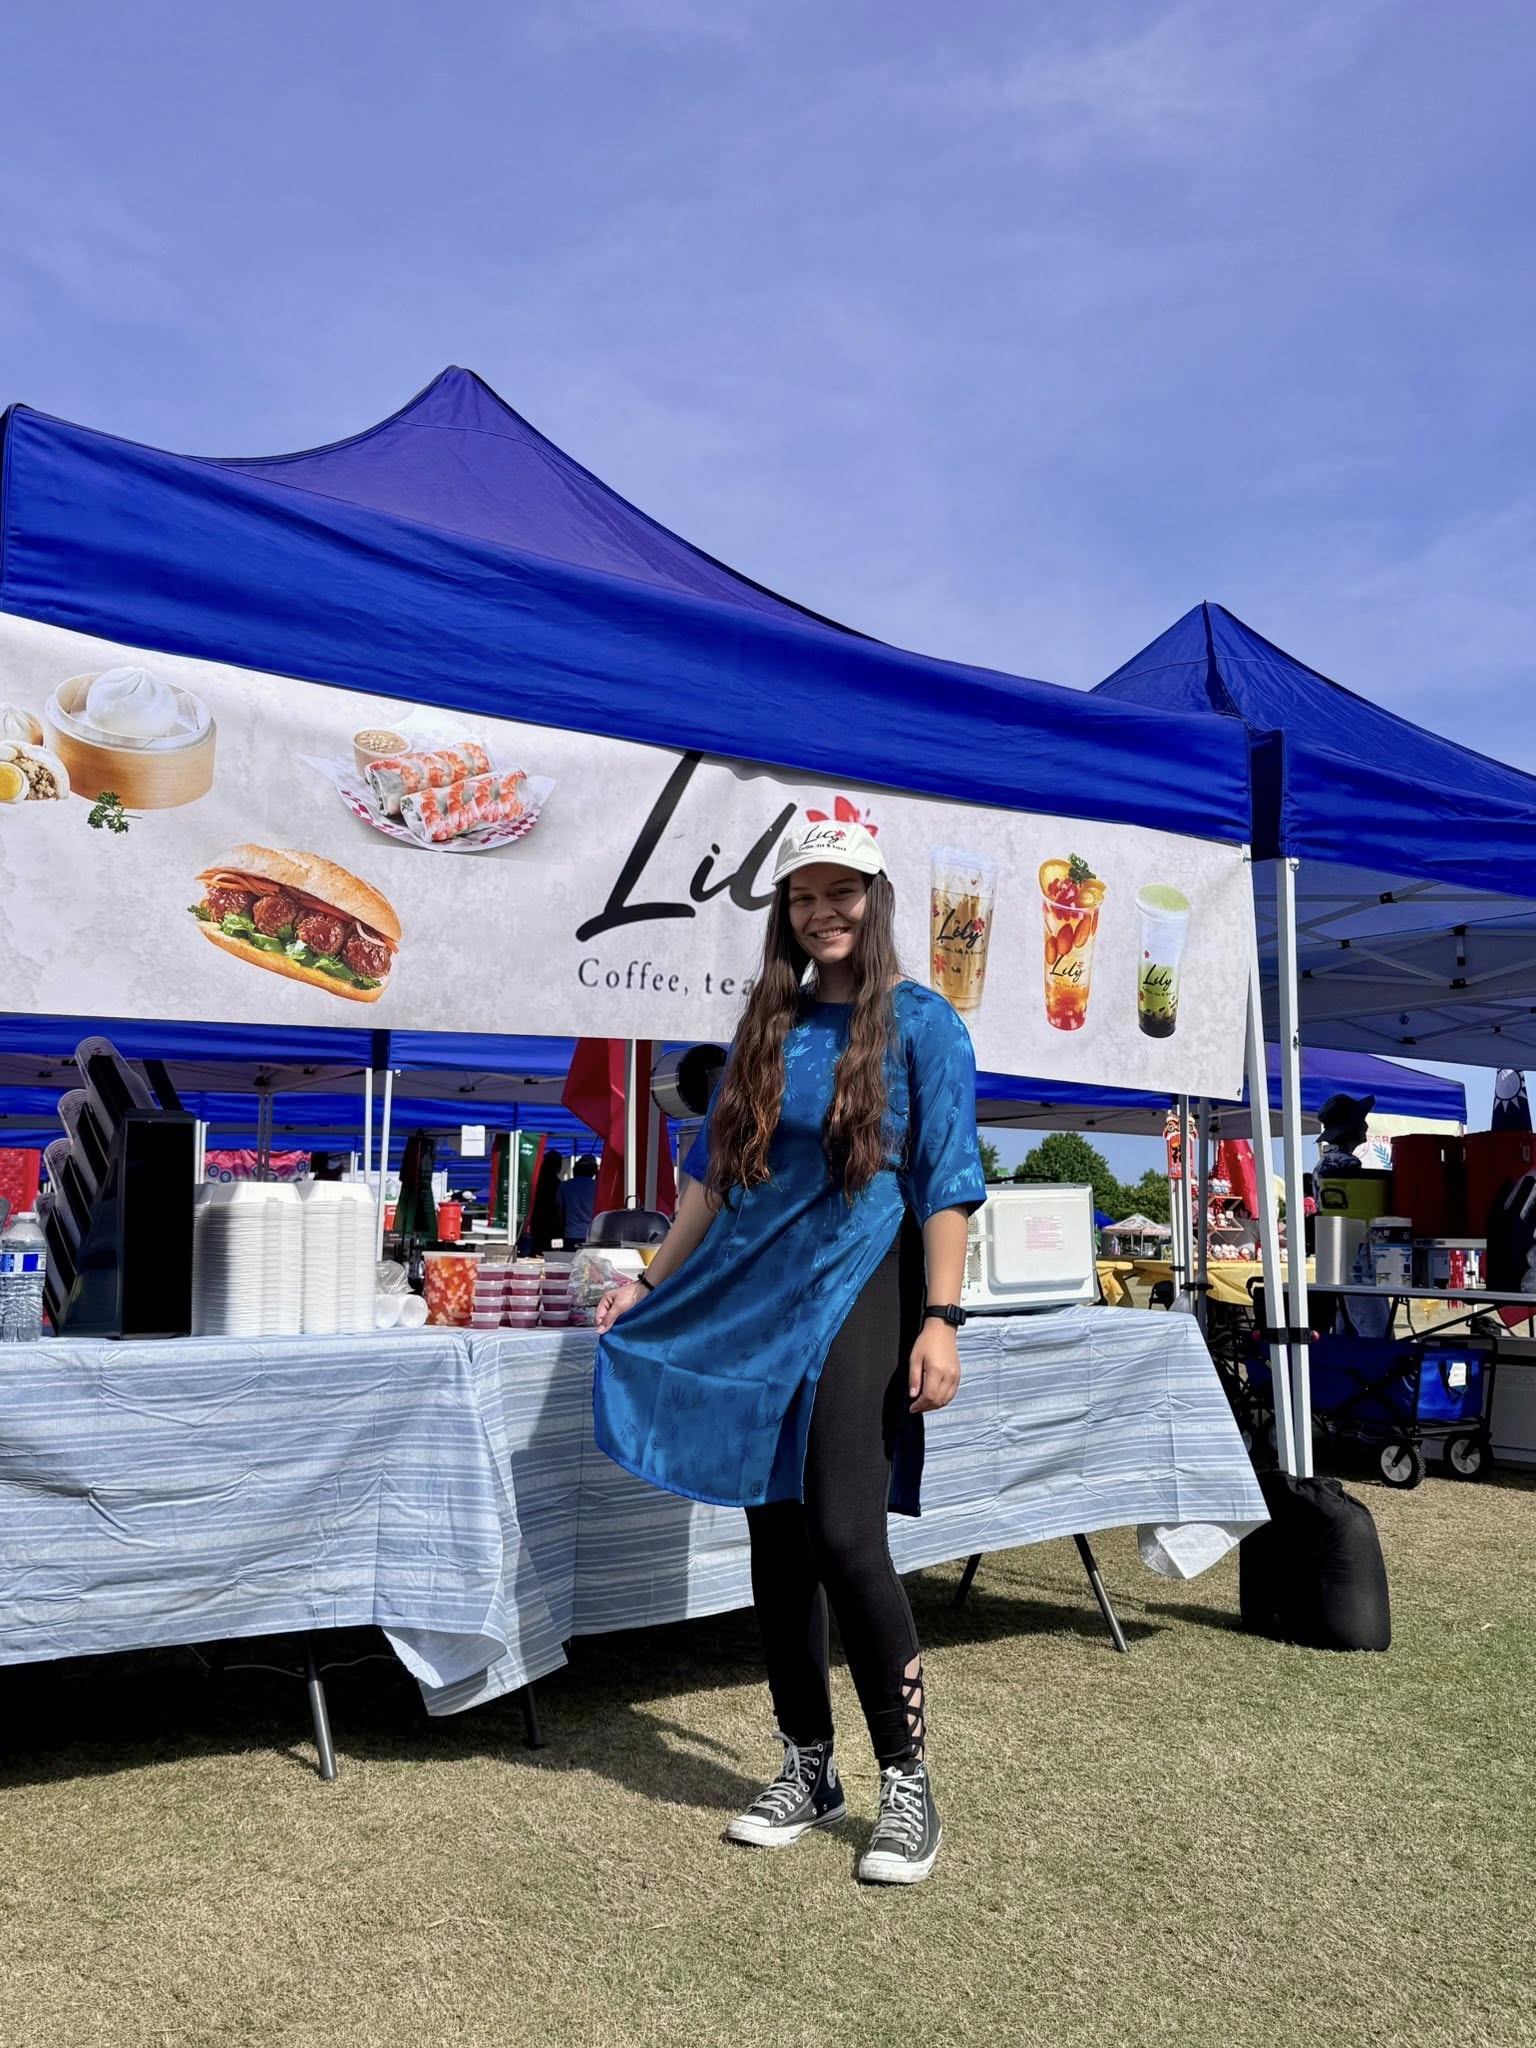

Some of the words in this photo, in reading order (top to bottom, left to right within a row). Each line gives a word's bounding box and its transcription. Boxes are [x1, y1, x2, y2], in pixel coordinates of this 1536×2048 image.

[575, 750, 798, 942] Lil
[936, 909, 983, 949] Lily
[578, 958, 689, 996] Coffee,
[1050, 955, 1086, 983] Lily
[1143, 964, 1172, 992] Lily
